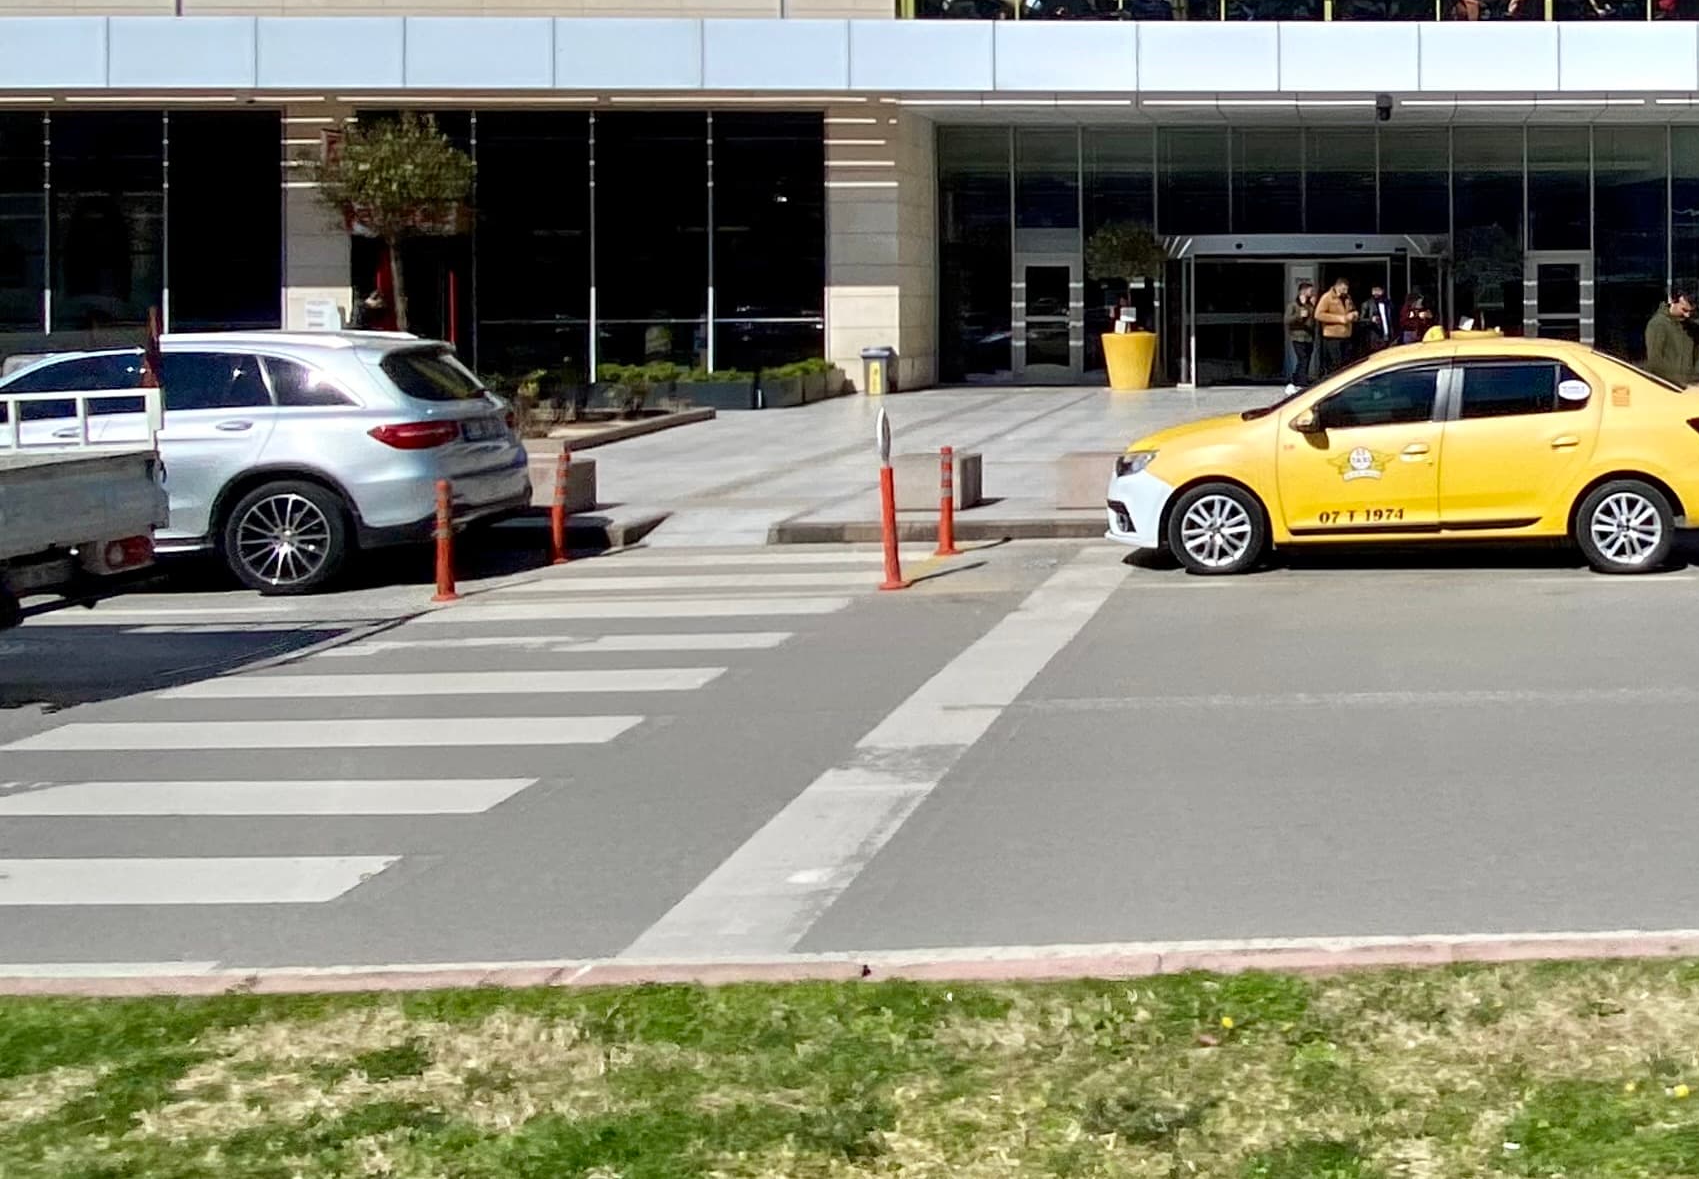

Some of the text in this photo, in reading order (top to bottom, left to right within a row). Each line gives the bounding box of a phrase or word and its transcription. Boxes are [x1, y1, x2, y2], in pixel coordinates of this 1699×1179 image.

[1319, 507, 1405, 524] 07 T 1974
